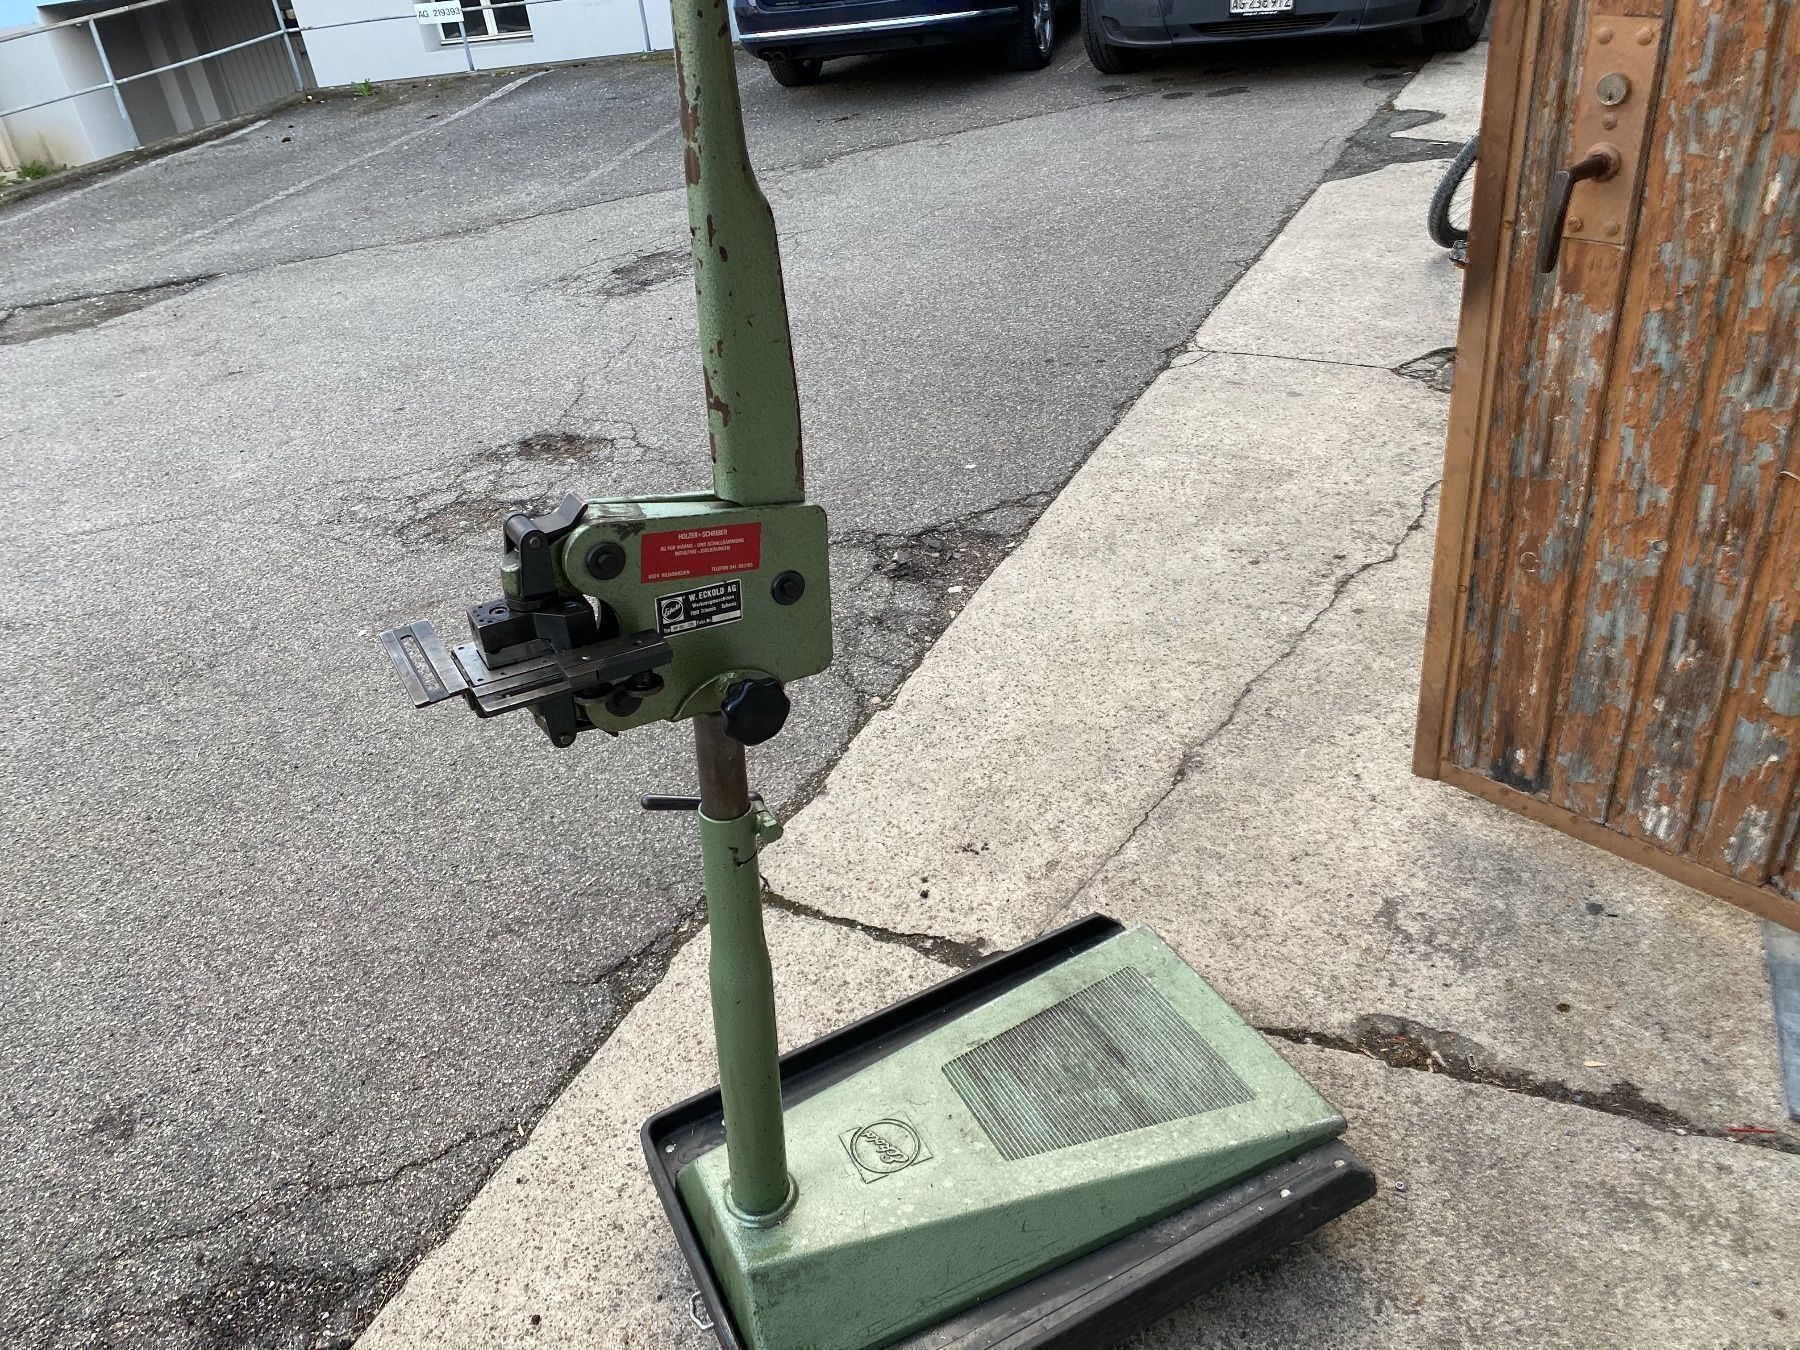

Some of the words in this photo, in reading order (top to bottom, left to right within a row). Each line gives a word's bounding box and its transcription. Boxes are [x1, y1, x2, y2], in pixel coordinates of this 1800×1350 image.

[418, 10, 430, 18] AG
[432, 7, 461, 17] 219393
[678, 531, 698, 540] HOLZER
[688, 593, 698, 602] W.
[698, 587, 724, 600] ECKOLD
[727, 584, 737, 593] AG
